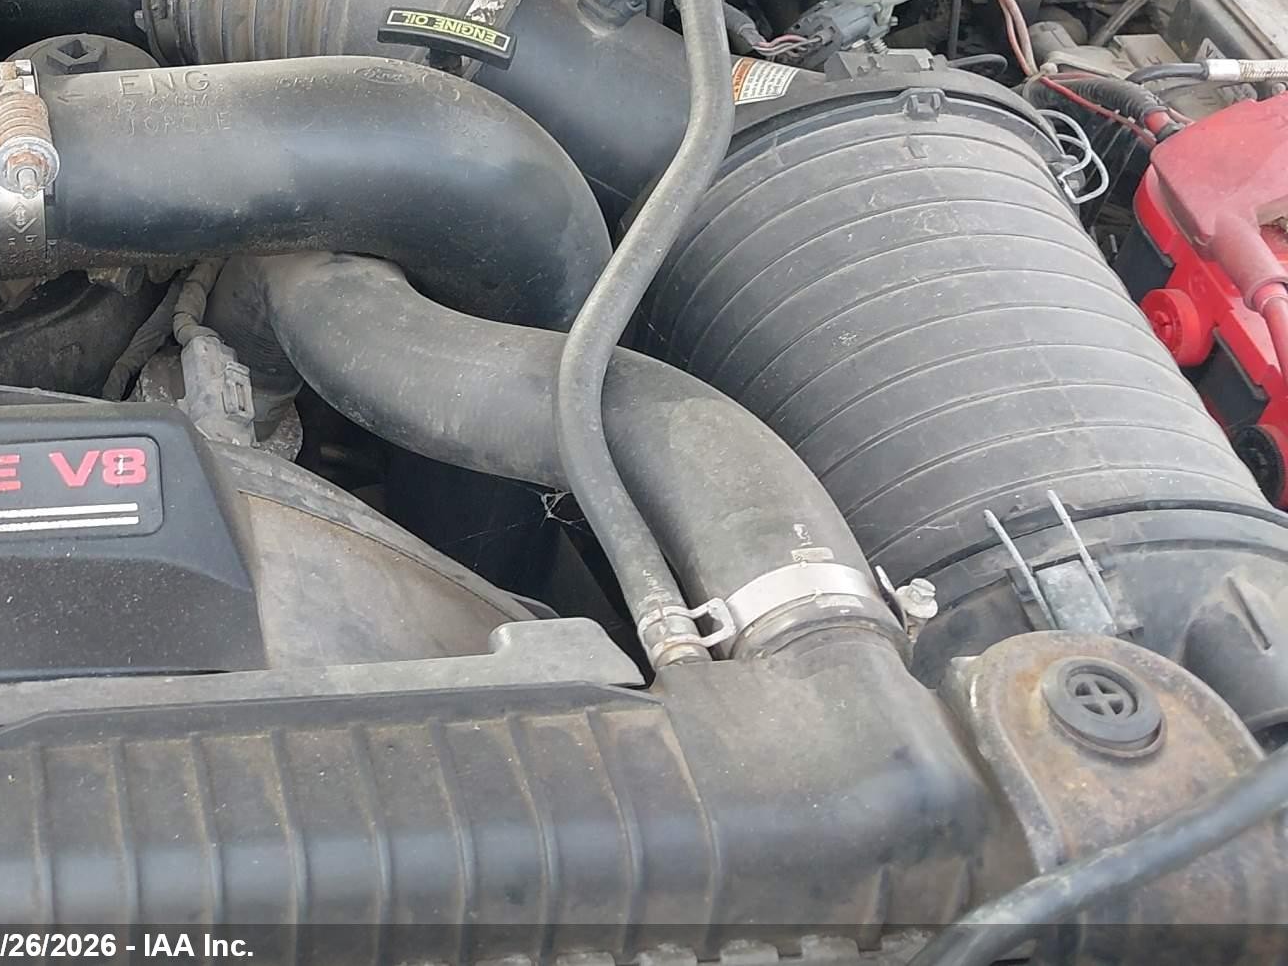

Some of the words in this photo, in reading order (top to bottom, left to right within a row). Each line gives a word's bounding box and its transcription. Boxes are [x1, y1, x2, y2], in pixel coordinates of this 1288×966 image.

[401, 12, 429, 26] OIL
[433, 17, 497, 44] ENGINE
[49, 447, 147, 487] V8
